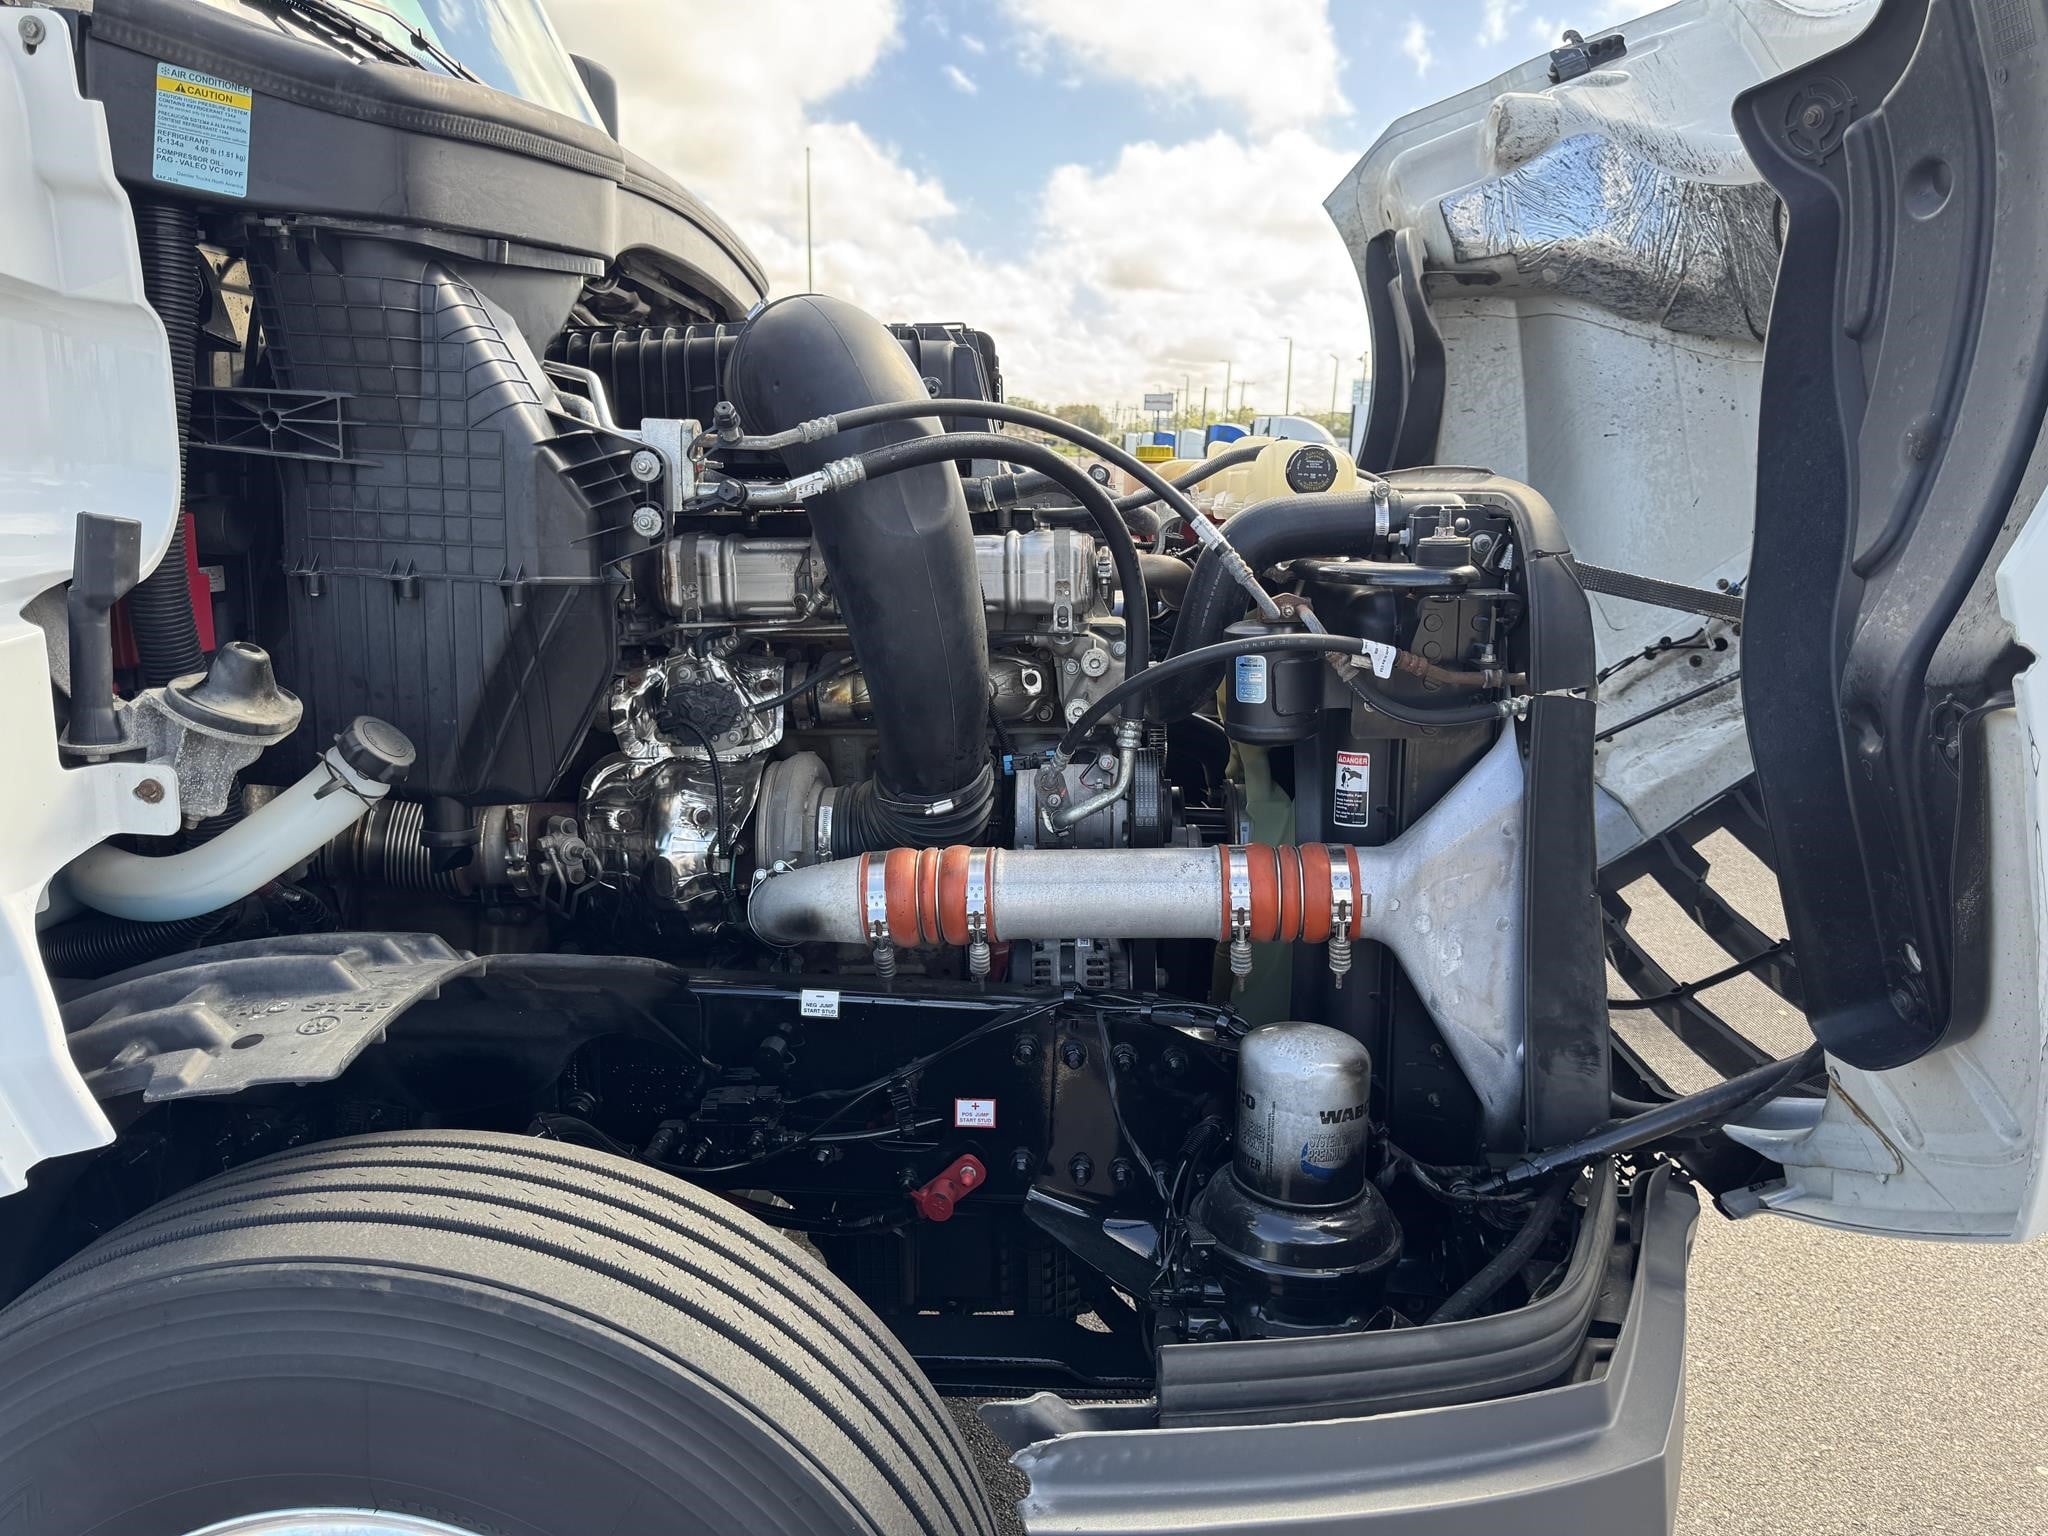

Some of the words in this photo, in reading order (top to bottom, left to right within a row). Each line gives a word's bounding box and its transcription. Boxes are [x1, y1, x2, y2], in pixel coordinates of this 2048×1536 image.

[171, 69, 186, 80] AIR
[189, 72, 249, 94] CONDITIONER
[158, 92, 182, 102] CAUTION
[198, 100, 226, 112] PRESSURE
[227, 107, 248, 116] SYSTEM
[188, 86, 233, 104] CAUTION
[158, 97, 186, 107] CONTAINS
[186, 103, 224, 115] REFRIGERANT
[156, 136, 184, 148] R-134a
[195, 145, 209, 153] 4.00
[236, 153, 246, 162] kg)
[156, 148, 208, 164] COMPRESSOR
[156, 154, 174, 163] PAG
[180, 158, 207, 170] VALEO
[208, 166, 244, 178] VC100YF
[1342, 756, 1368, 765] DANGER
[301, 1001, 392, 1012] STEP
